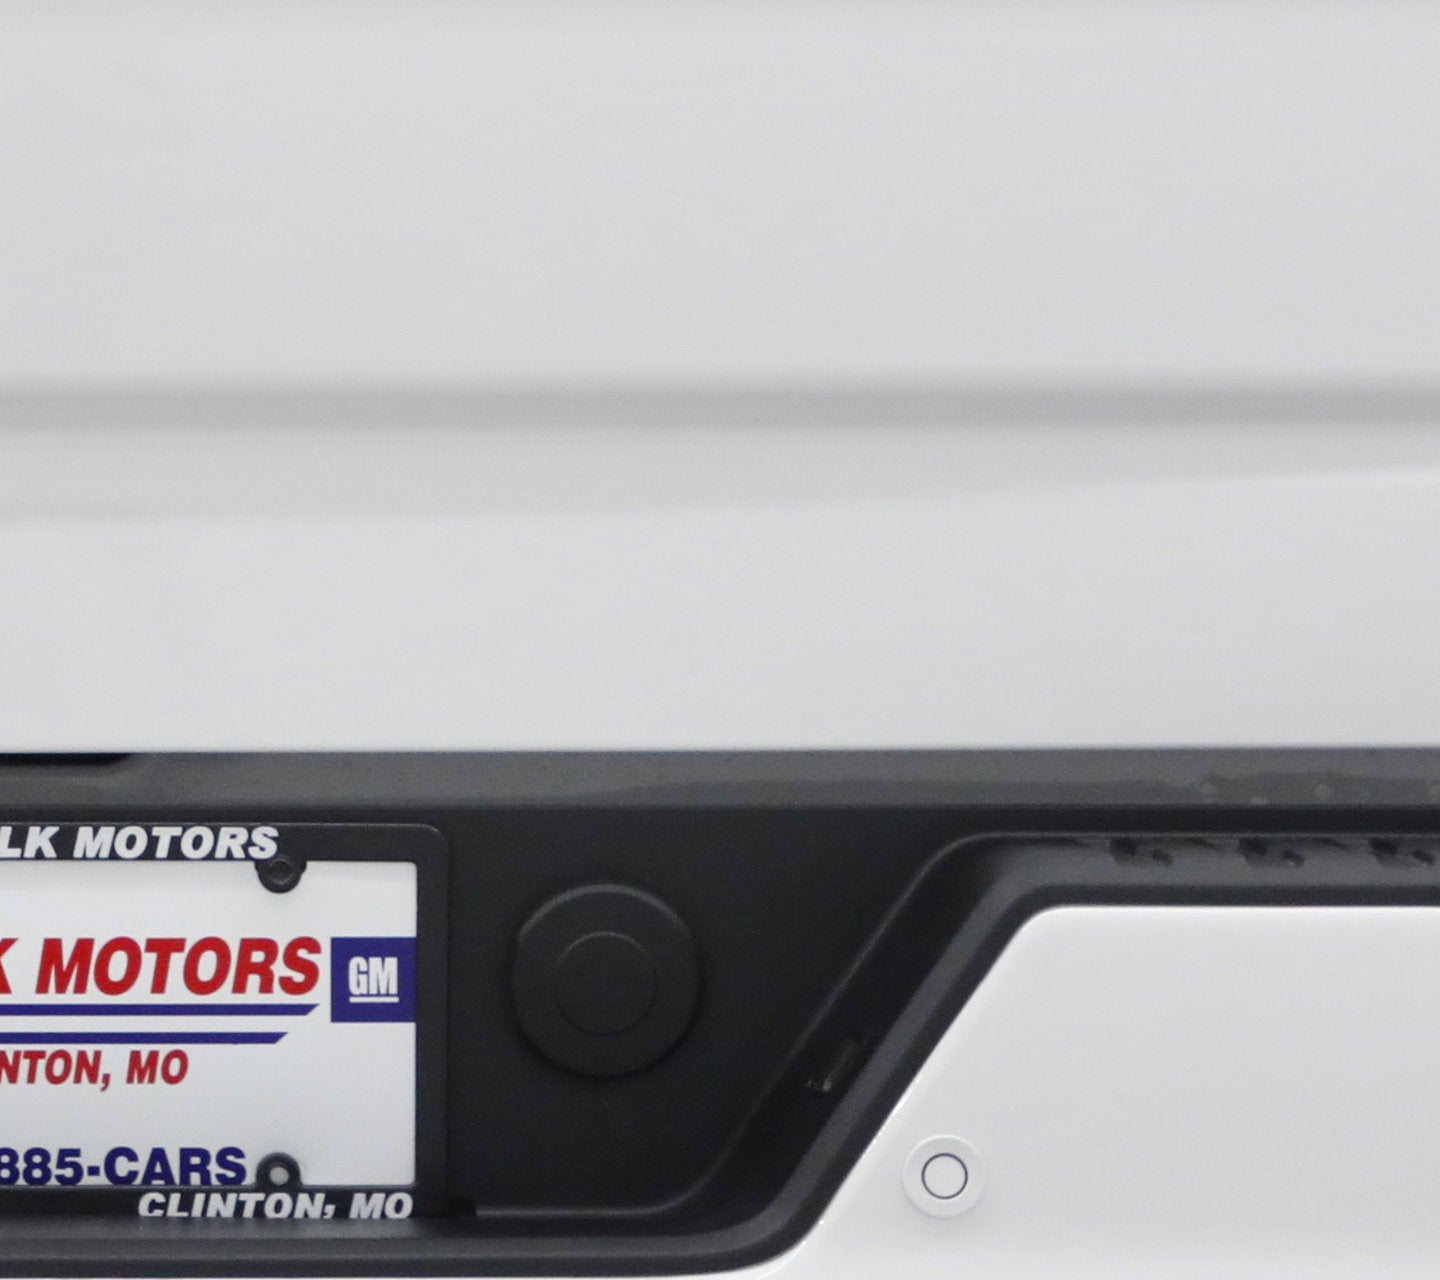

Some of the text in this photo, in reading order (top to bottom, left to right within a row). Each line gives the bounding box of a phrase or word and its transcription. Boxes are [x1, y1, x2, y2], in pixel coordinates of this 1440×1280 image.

[72, 825, 280, 859] MOTORS
[36, 936, 323, 996] MOTORS
[347, 957, 400, 996] GM
[125, 1049, 190, 1086] MO
[137, 1192, 415, 1220] CLINTON, MO
